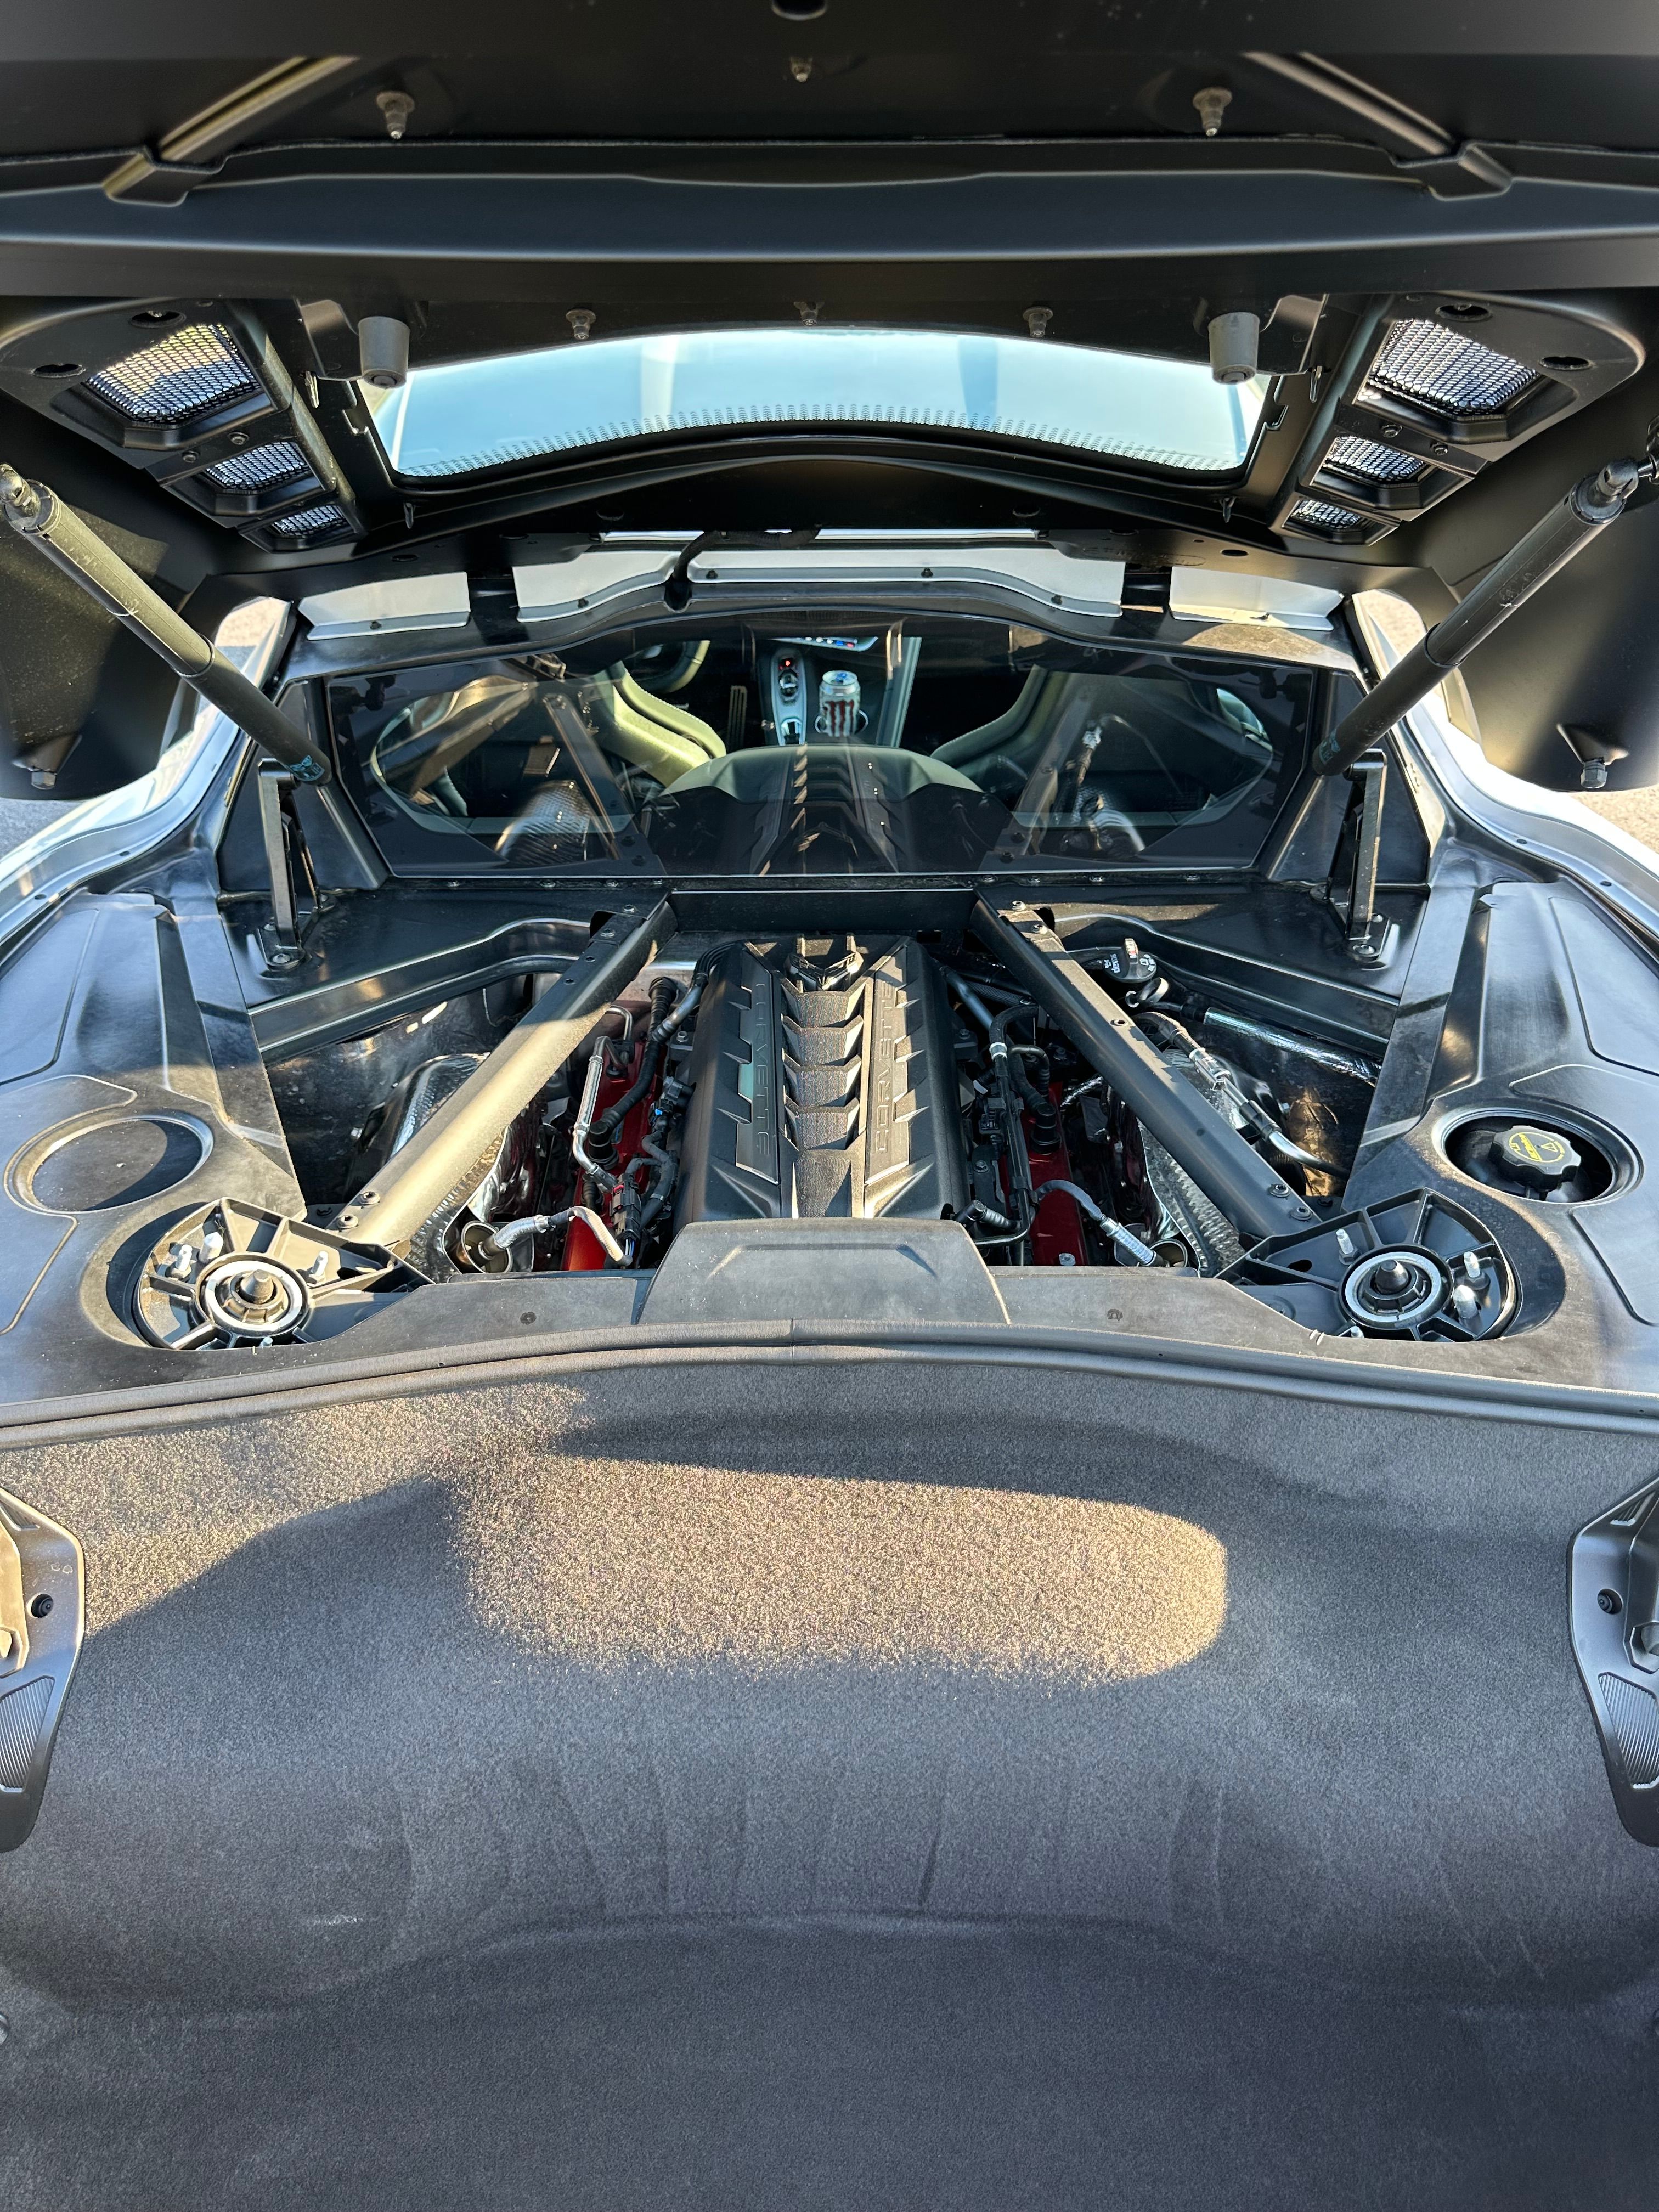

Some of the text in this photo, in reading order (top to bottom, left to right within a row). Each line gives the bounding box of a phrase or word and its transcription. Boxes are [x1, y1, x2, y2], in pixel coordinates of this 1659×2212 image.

[1110, 953, 1120, 973] dexos
[755, 983, 770, 1155] CORVETTE
[876, 980, 893, 1153] CORVETTE
